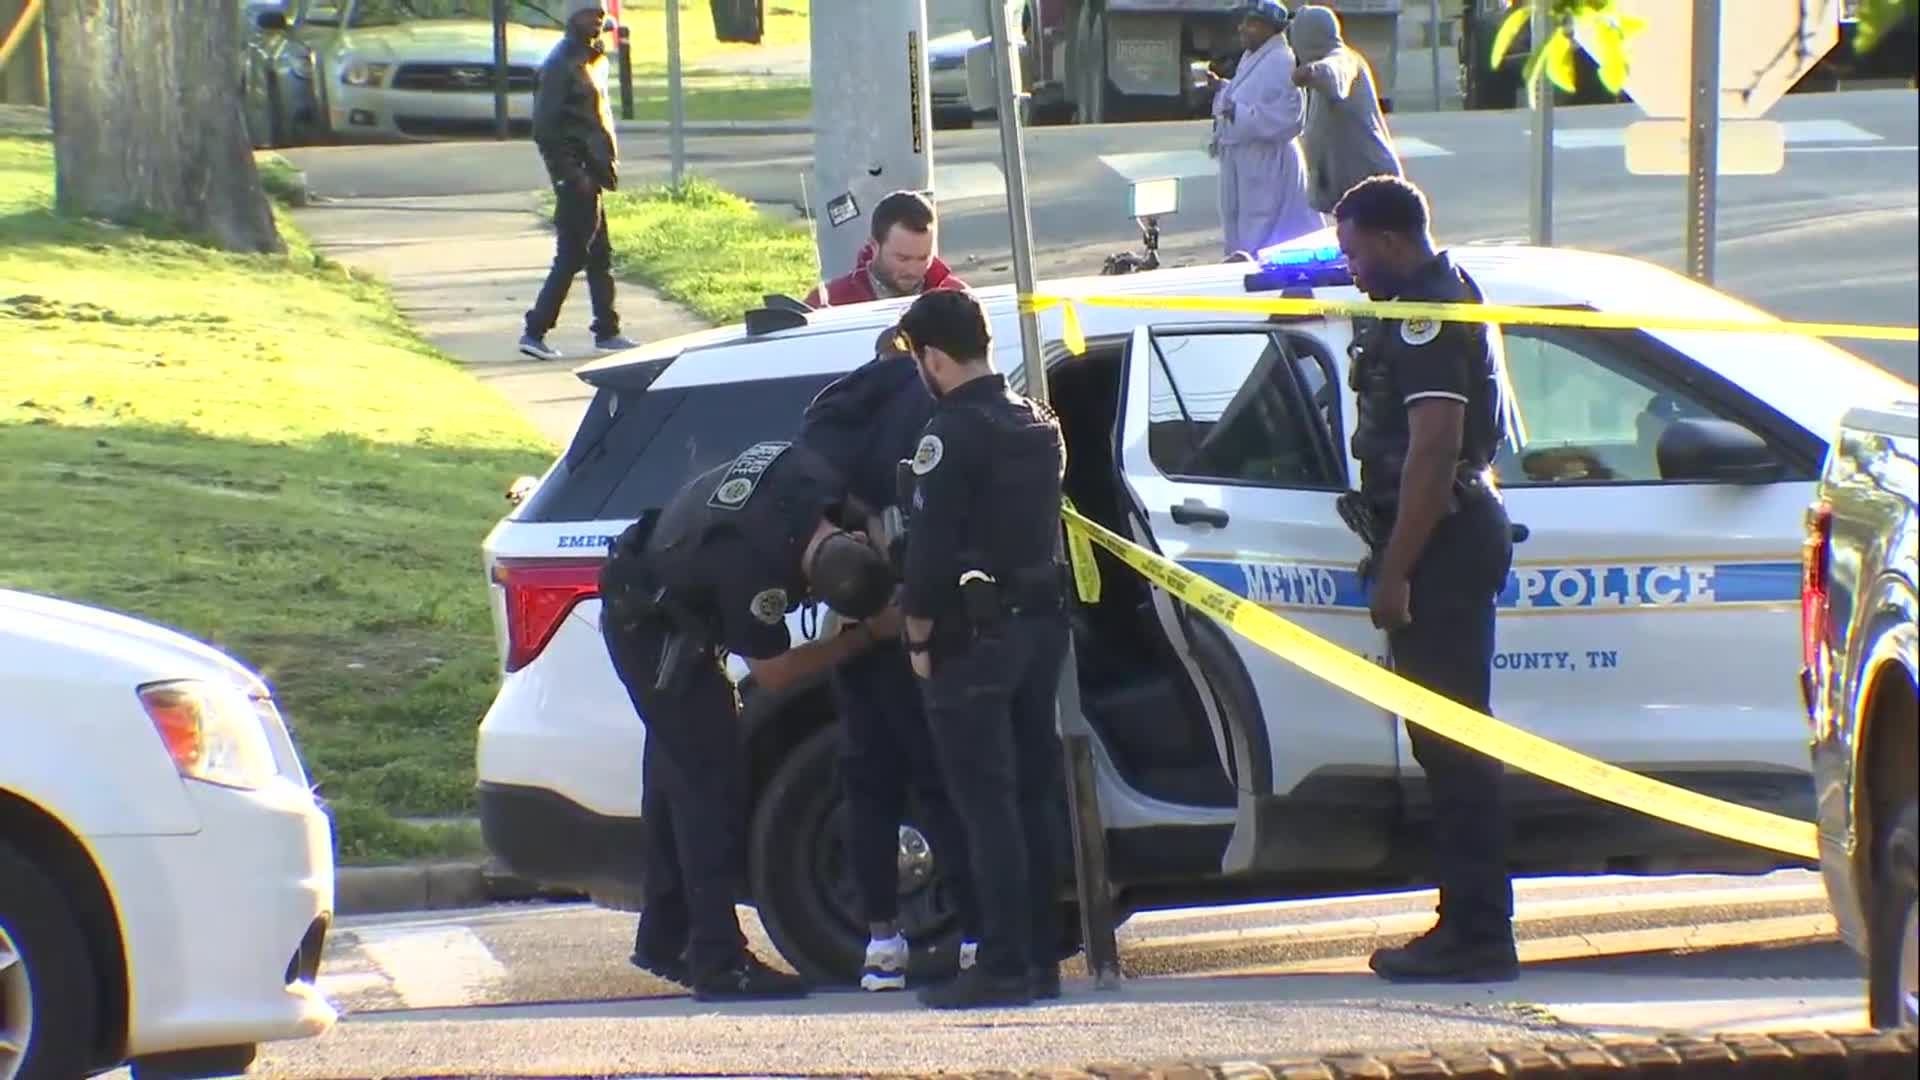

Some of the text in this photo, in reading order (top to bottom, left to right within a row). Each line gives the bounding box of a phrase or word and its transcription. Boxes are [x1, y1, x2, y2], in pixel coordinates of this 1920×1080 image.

[557, 535, 608, 548] EMER
[1240, 563, 1336, 607] METRO
[1515, 564, 1715, 608] POLICE
[1493, 650, 1618, 671] OUNTY, TN
